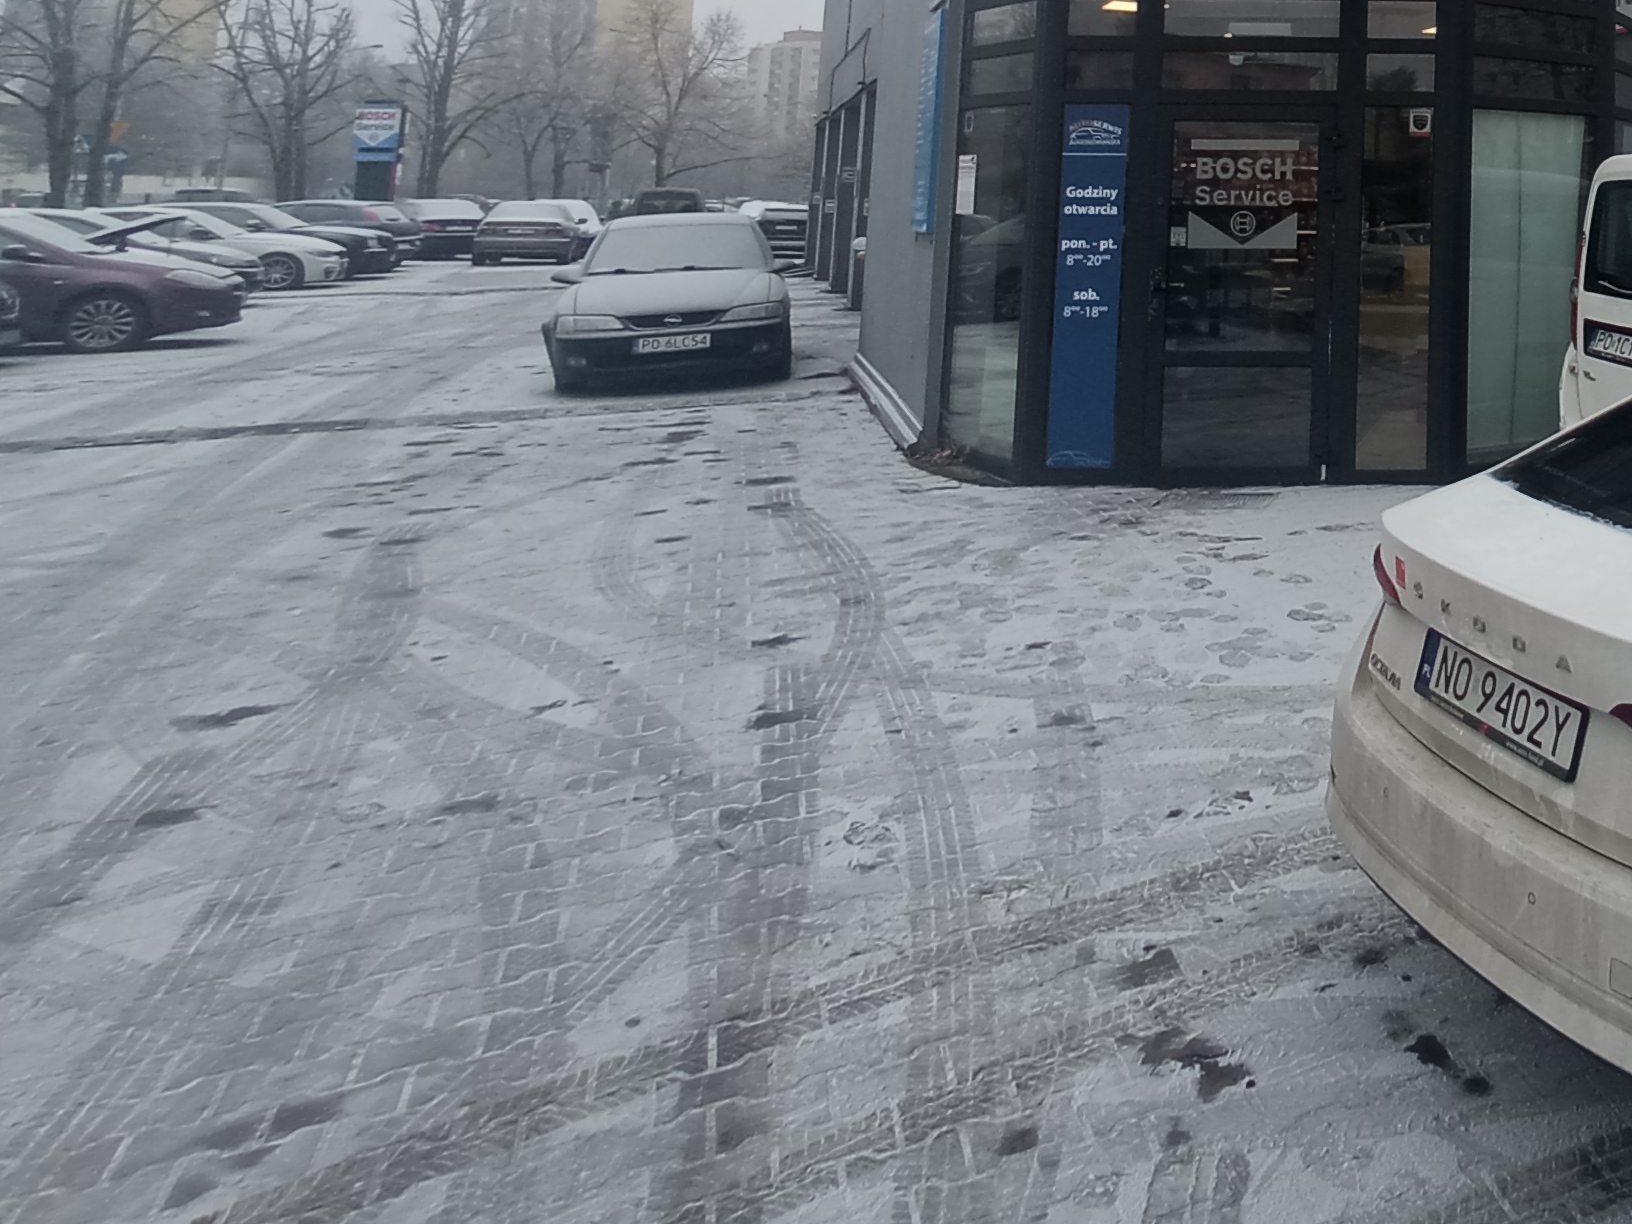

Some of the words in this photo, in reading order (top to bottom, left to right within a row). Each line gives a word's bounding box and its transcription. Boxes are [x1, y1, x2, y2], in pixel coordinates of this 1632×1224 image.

[1196, 157, 1294, 180] BOSCH
[1065, 186, 1118, 201] Godziny
[1195, 184, 1293, 206] Service
[1063, 203, 1118, 215] otwarcia
[1072, 288, 1100, 300] sob.
[1435, 645, 1473, 701] NO
[1476, 671, 1572, 757] 9402Y
